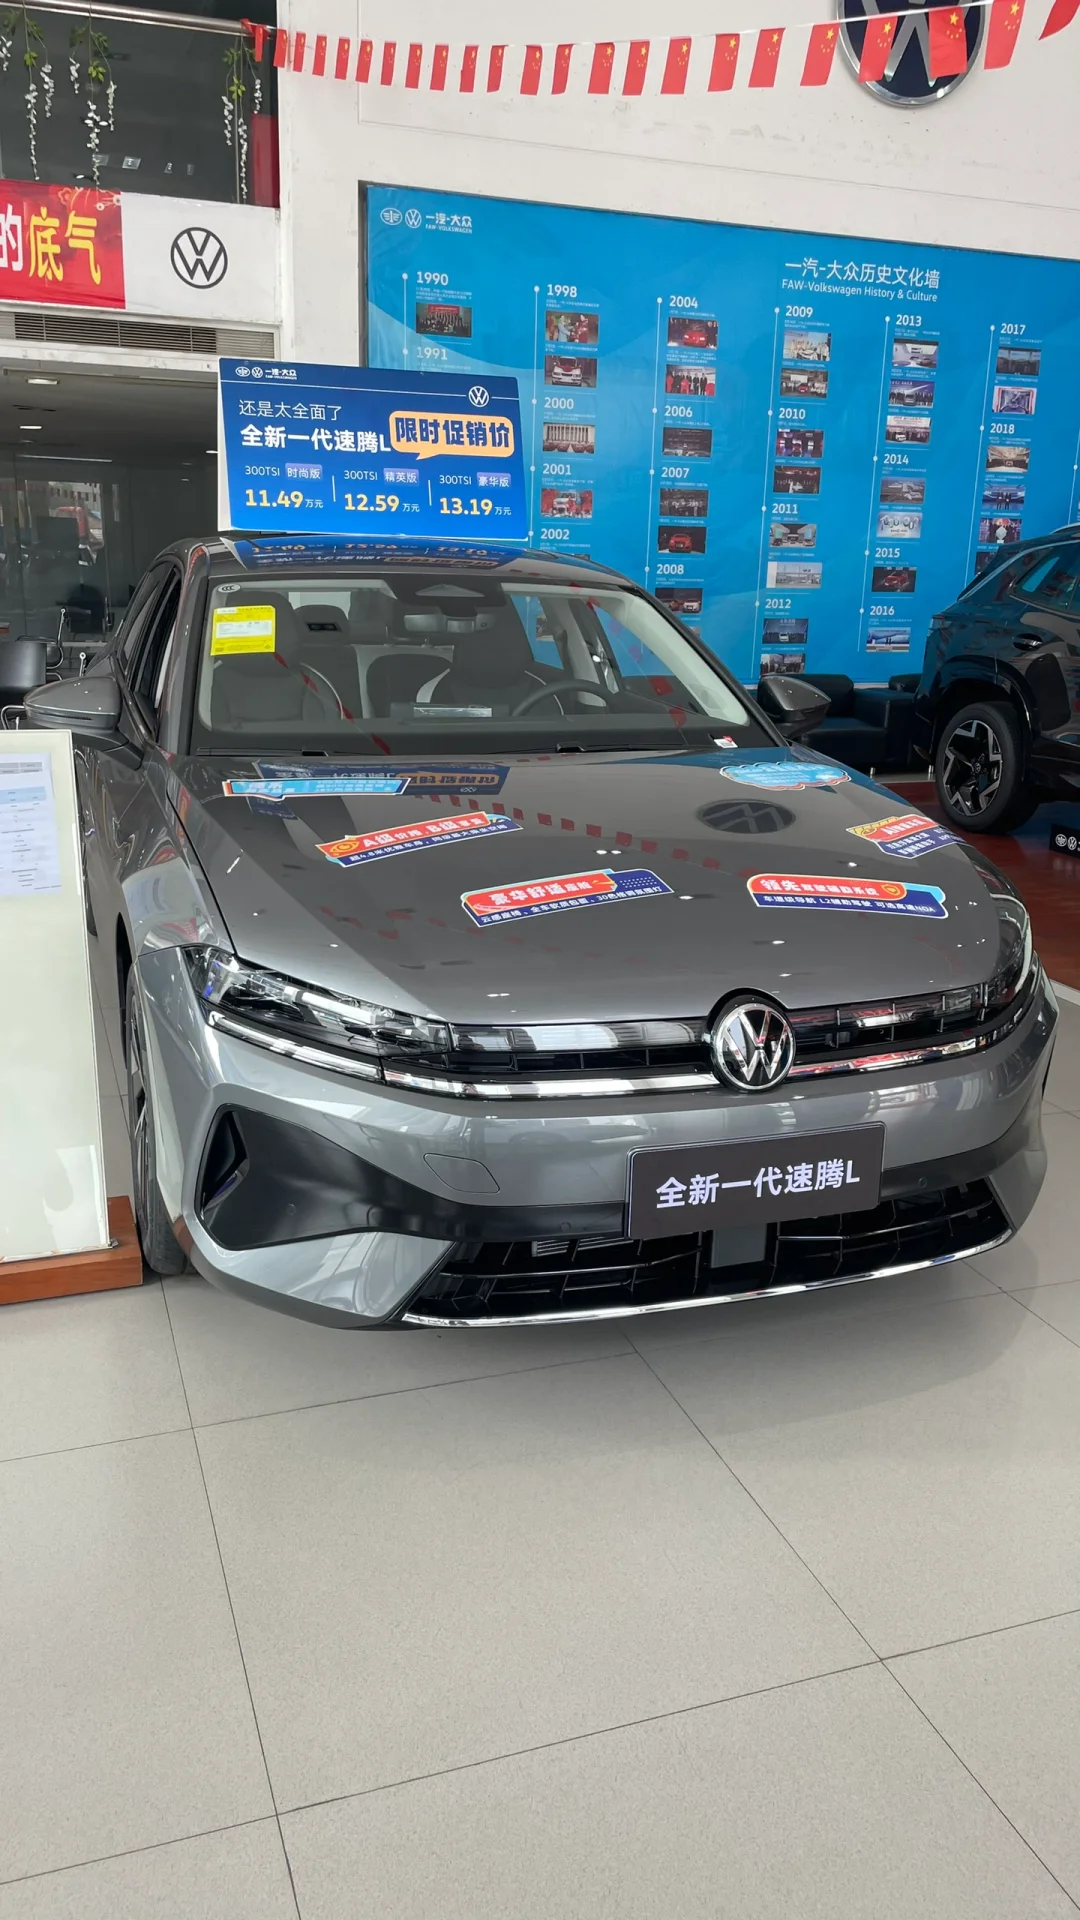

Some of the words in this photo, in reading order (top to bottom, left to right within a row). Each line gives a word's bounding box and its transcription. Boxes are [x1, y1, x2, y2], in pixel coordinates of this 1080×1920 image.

[416, 271, 449, 286] 1990
[785, 257, 940, 289] 一汽-大众历史文化墙
[547, 284, 578, 298] 1998
[781, 279, 862, 297] FAW-Volkswagen
[864, 286, 895, 301] History
[897, 290, 904, 299] &
[906, 290, 938, 302] Culture
[669, 296, 698, 309] 2004
[785, 305, 813, 318] 2009
[895, 314, 922, 327] 2013
[1000, 323, 1026, 335] 2017
[416, 346, 448, 360] 1991
[239, 399, 342, 421] 还是太全面了
[544, 397, 574, 410] 2000
[664, 405, 693, 418] 2006
[778, 407, 806, 420] 2010
[395, 417, 510, 448] 限时促销价
[989, 423, 1015, 434] 2018
[240, 423, 391, 454] 全新一代速腾L
[883, 454, 909, 465] 2014
[244, 465, 280, 477] 300TSI
[287, 467, 321, 480] 时尚版
[542, 463, 572, 476] 2001
[661, 466, 690, 479] 2007
[343, 470, 378, 481] 300TSI
[384, 471, 418, 484] 精英版
[439, 475, 472, 485] 300TSI
[478, 476, 510, 488] 豪华版
[245, 489, 303, 508] 11.49
[344, 493, 399, 512] 12.59
[440, 497, 493, 516] 13.19
[771, 503, 798, 514] 2011
[540, 528, 570, 540] 2002
[875, 547, 900, 558] 2015
[656, 563, 685, 575] 2008
[765, 598, 792, 609] 2012
[869, 605, 895, 616] 2016
[489, 881, 593, 906] 豪华舒适座舱
[656, 1158, 860, 1209] 全新一代速腾L
